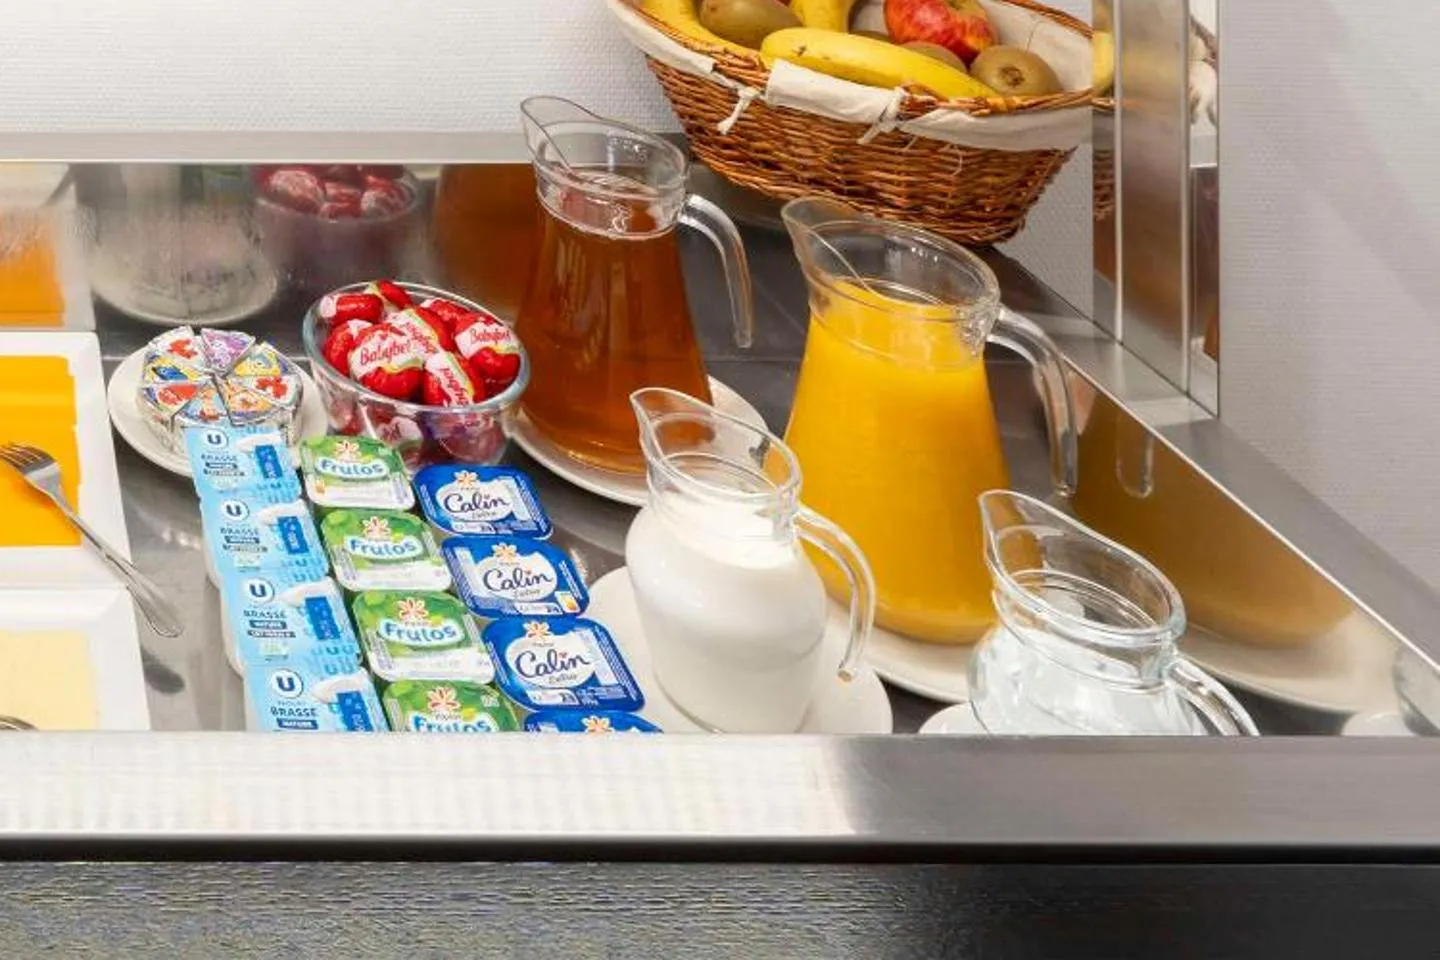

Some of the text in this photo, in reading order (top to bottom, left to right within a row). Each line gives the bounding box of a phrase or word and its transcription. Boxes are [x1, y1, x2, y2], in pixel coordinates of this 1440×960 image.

[360, 339, 411, 365] Babybel
[226, 504, 242, 517] U
[249, 583, 267, 598] U
[515, 648, 590, 679] Calin
[276, 676, 295, 691] U
